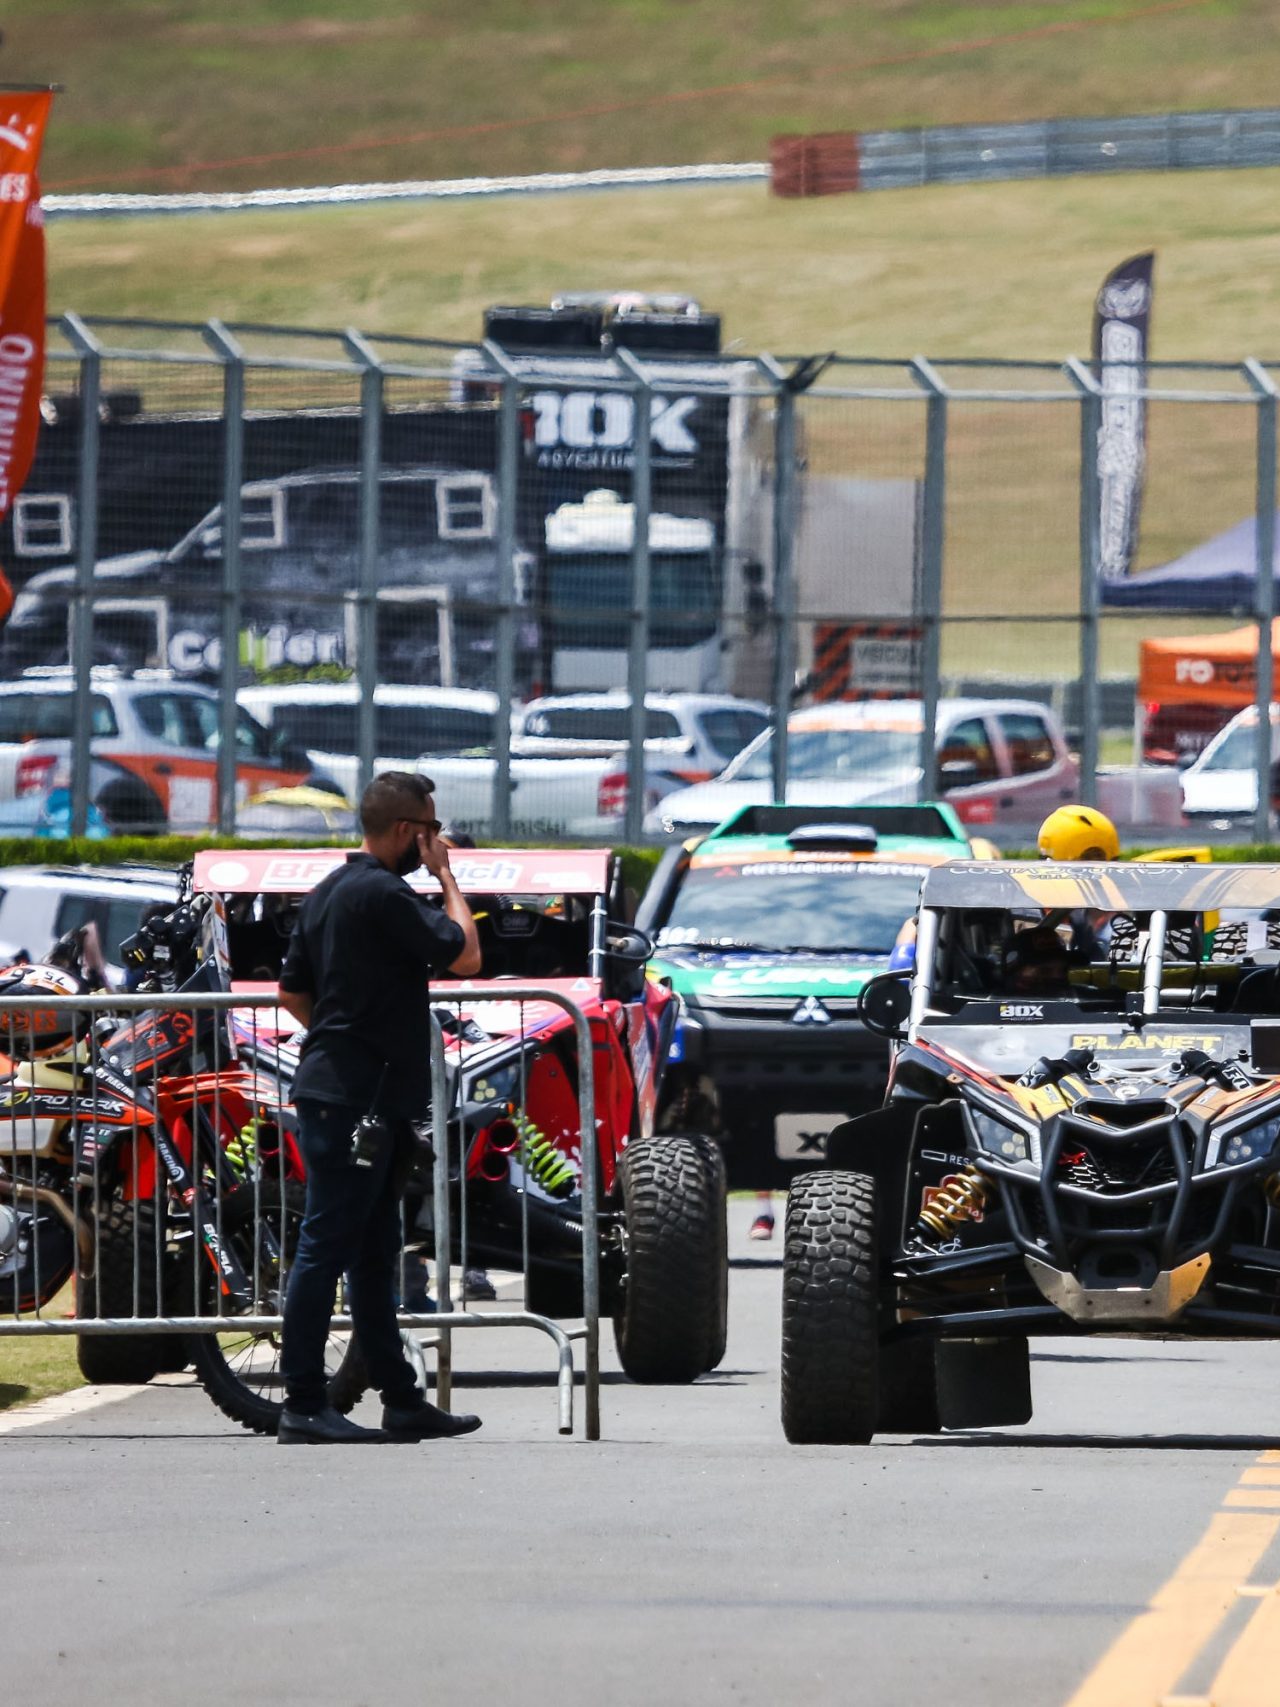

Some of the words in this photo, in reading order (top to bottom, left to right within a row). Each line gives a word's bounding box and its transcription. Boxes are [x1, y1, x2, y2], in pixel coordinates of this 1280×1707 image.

[857, 864, 932, 878] MOTOR
[999, 1004, 1045, 1017] BOX
[1072, 1034, 1222, 1051] PLANET
[1221, 1065, 1254, 1091] FO
[25, 1094, 65, 1106] PRO
[71, 1096, 126, 1113] TORK
